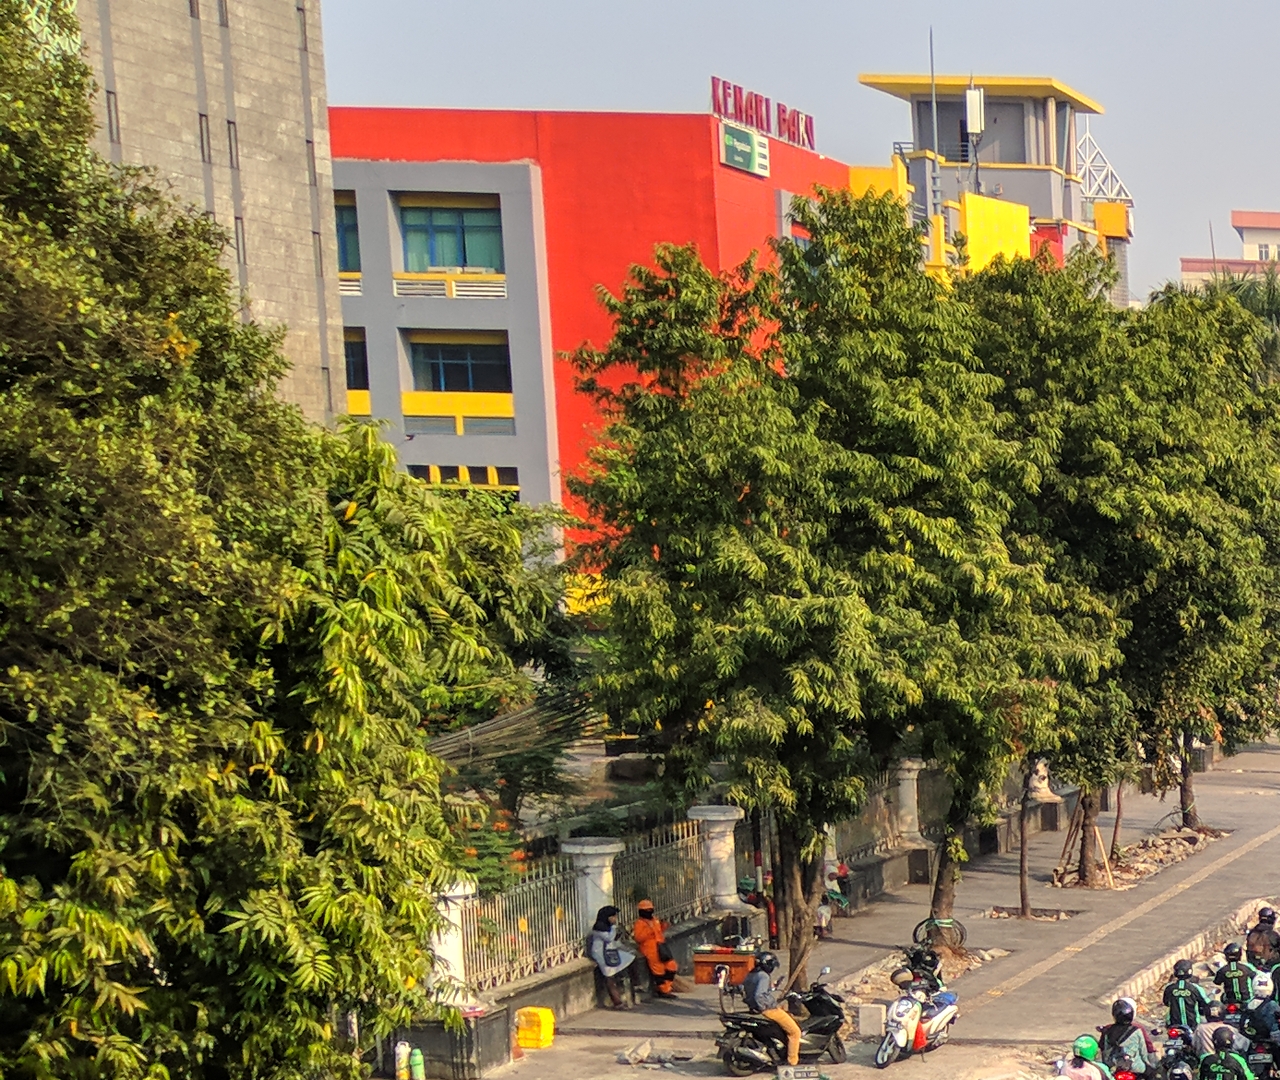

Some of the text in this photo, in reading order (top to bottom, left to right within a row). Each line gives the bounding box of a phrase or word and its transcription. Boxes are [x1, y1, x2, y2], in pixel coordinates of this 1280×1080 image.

[711, 75, 773, 135] KENARI
[1225, 971, 1243, 979] Grab
[1172, 989, 1191, 998] Grab
